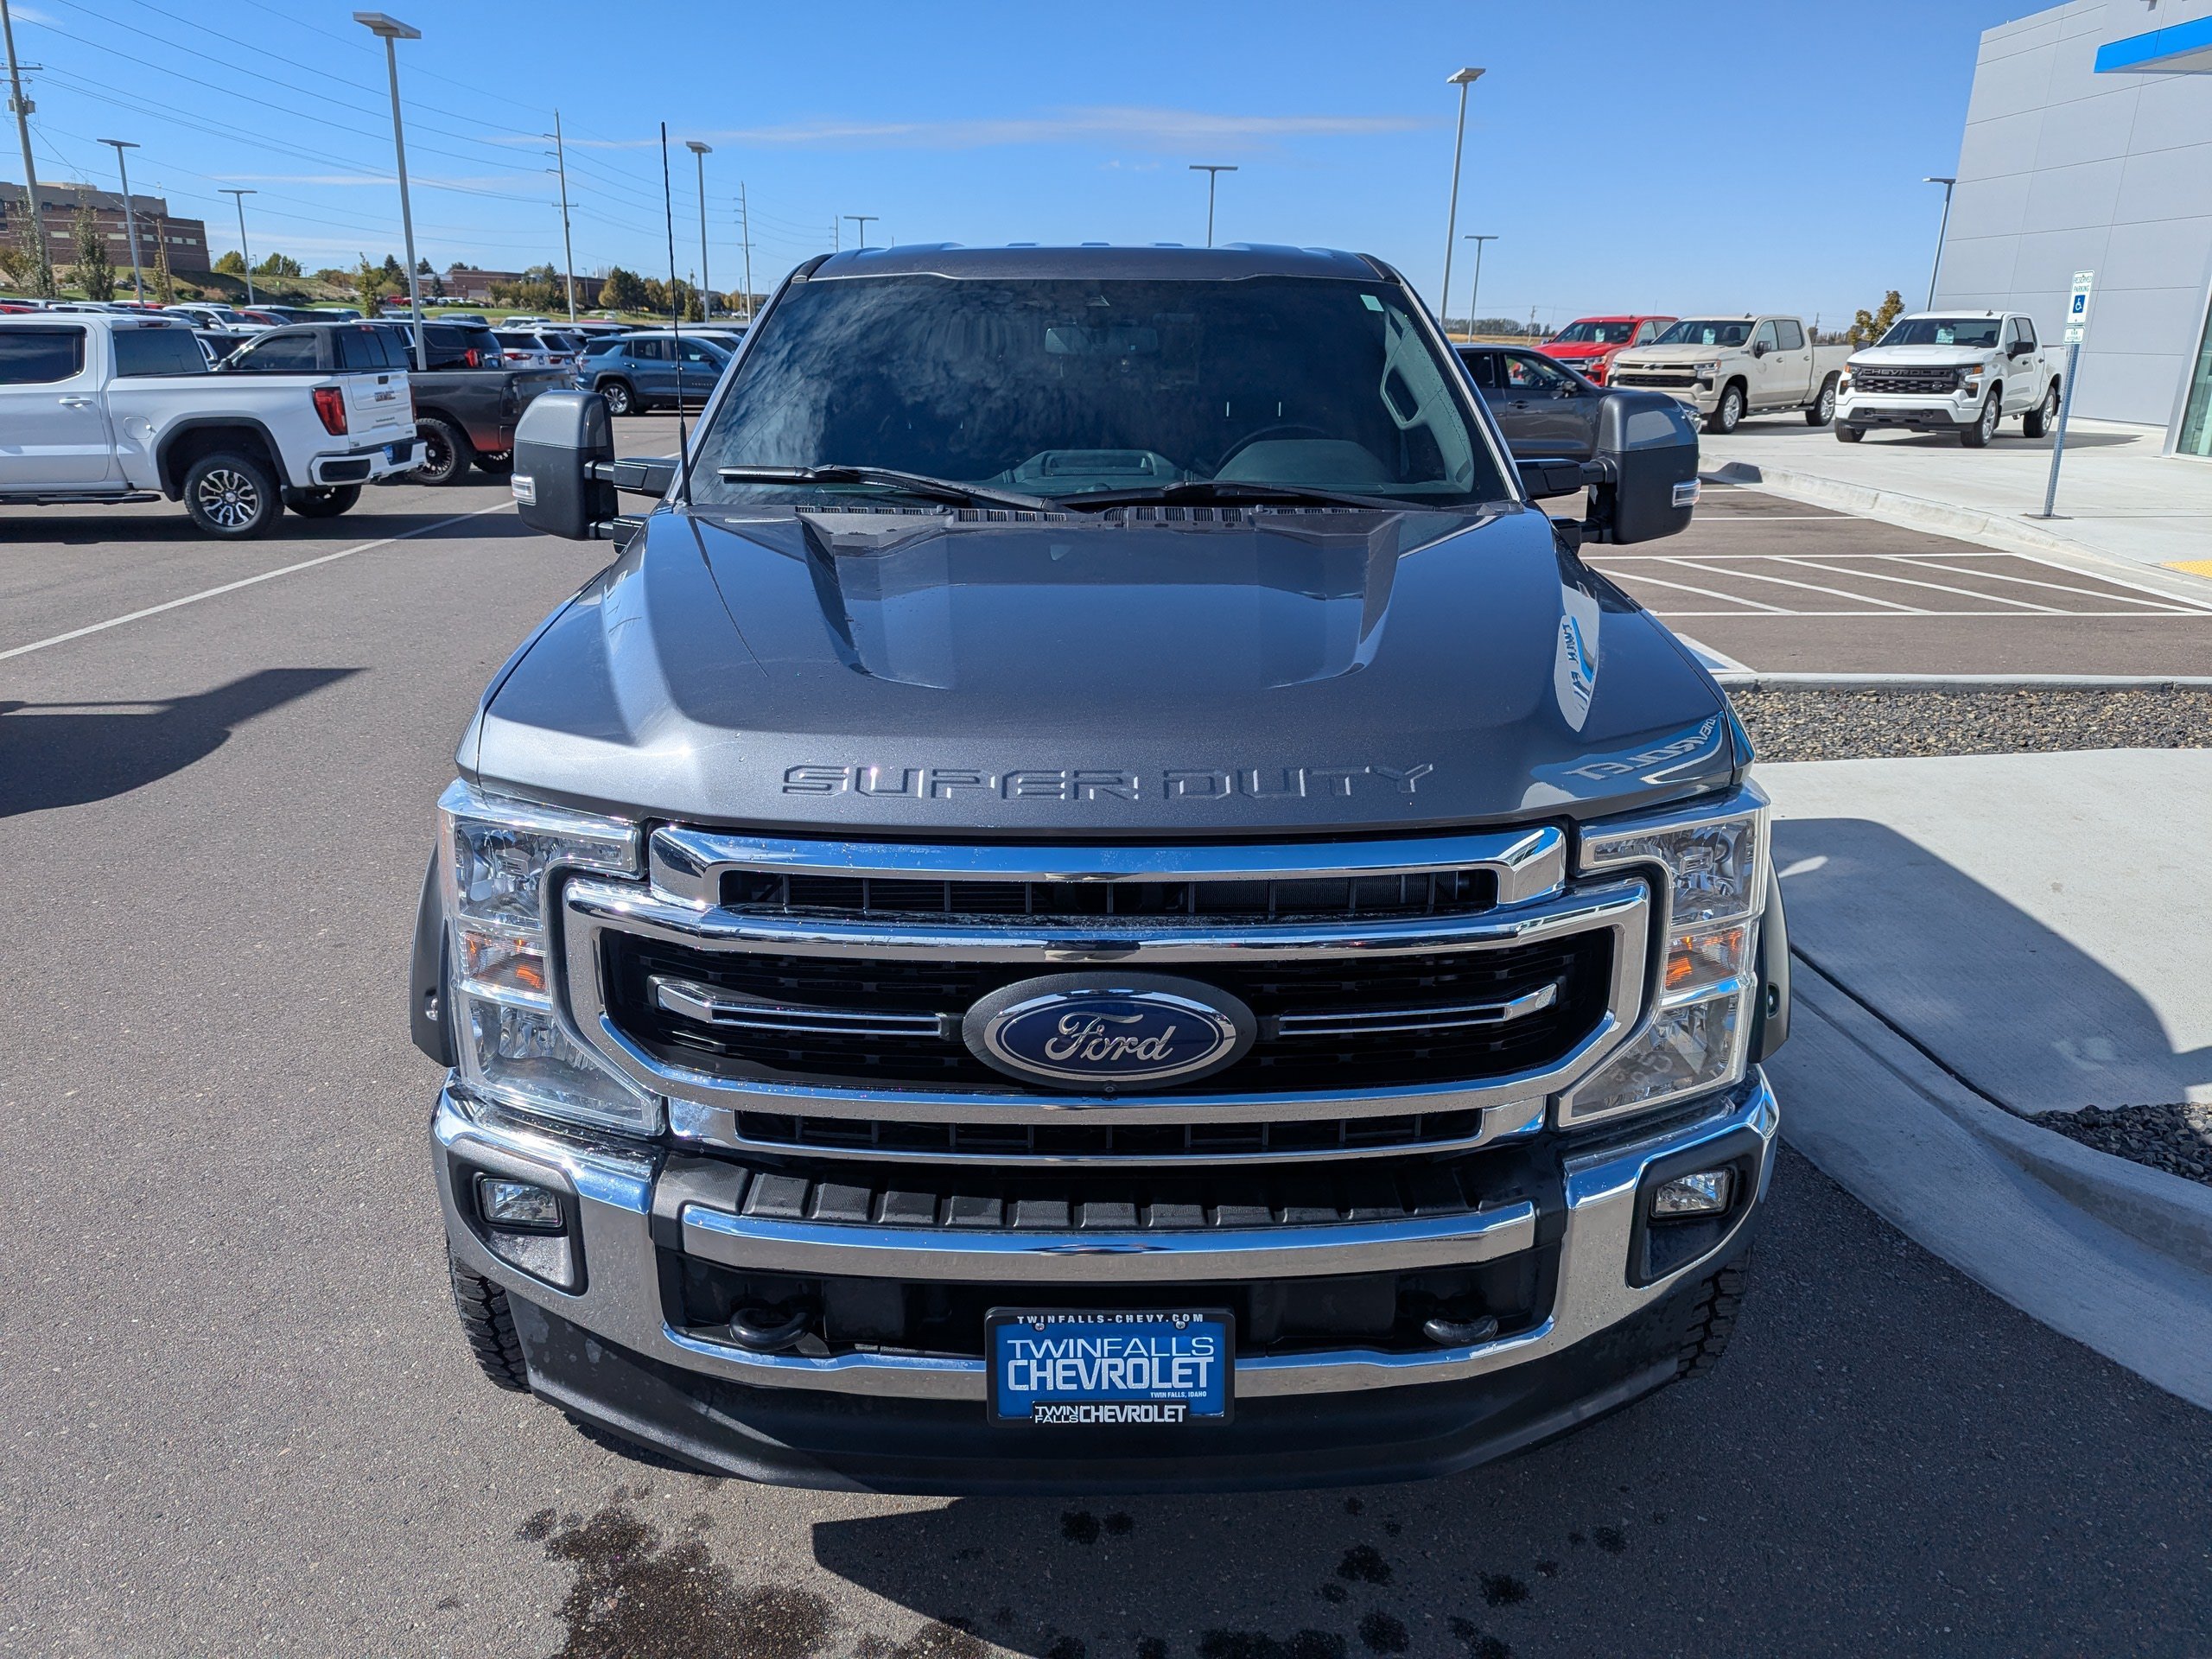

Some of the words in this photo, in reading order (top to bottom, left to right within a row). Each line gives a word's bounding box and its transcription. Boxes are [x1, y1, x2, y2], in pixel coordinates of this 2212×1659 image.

[1863, 367, 1948, 376] CHEVROLET
[782, 764, 1139, 800] SUPER
[1163, 763, 1435, 799] DUTY
[1045, 1011, 1176, 1061] Ford
[1017, 1313, 1204, 1324] TWINFALLS-CHEVY.COM
[1007, 1337, 1214, 1358] TWINFALLS
[1007, 1357, 1214, 1391] CHEVROLET
[1034, 1414, 1078, 1424] FALLS
[1035, 1406, 1078, 1415] TWIN
[1079, 1405, 1186, 1423] CHEVROLET
